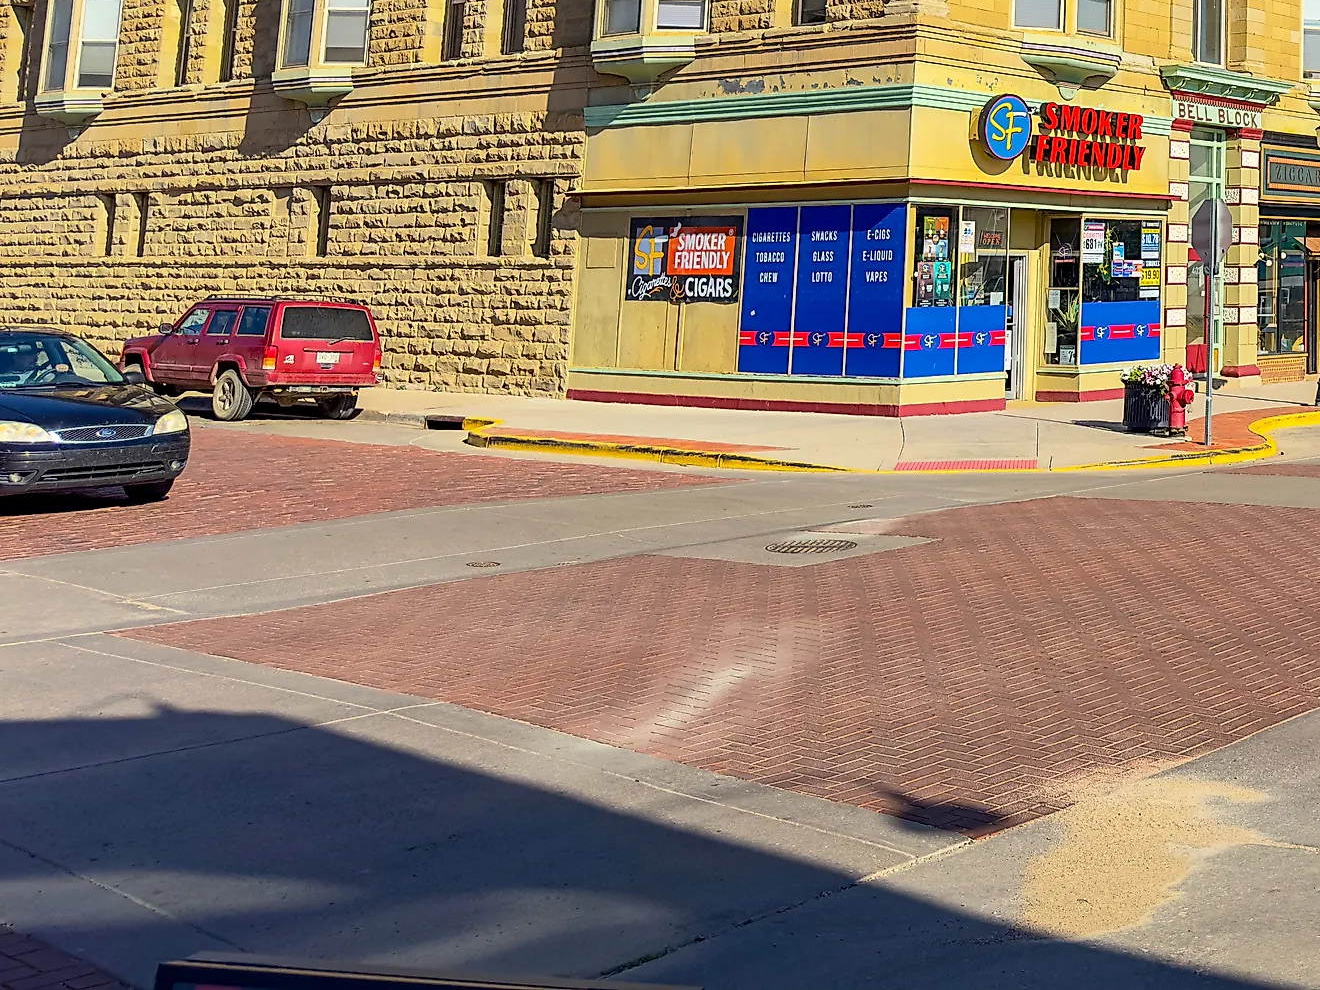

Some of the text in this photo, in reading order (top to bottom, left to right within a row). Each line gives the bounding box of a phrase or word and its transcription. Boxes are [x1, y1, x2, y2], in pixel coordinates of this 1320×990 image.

[1044, 102, 1144, 140] SMOKER
[1178, 103, 1258, 128] BELL BLOCK
[1035, 135, 1147, 170] FRIENDLY
[752, 231, 791, 242] CIGARETTES
[811, 230, 838, 242] SNACKS
[867, 229, 891, 241] E-CIGS
[677, 232, 726, 251] SMOKER
[674, 251, 730, 269] FRIENDLY
[755, 252, 785, 263] TOBACCO
[812, 251, 834, 262] GLASS
[862, 250, 893, 261] E-LIQUID
[759, 272, 779, 283] CHEW
[811, 272, 833, 283] LOTTO
[865, 271, 888, 283] VAPES
[632, 272, 672, 300] Cigarettes
[685, 277, 733, 297] CIGARS
